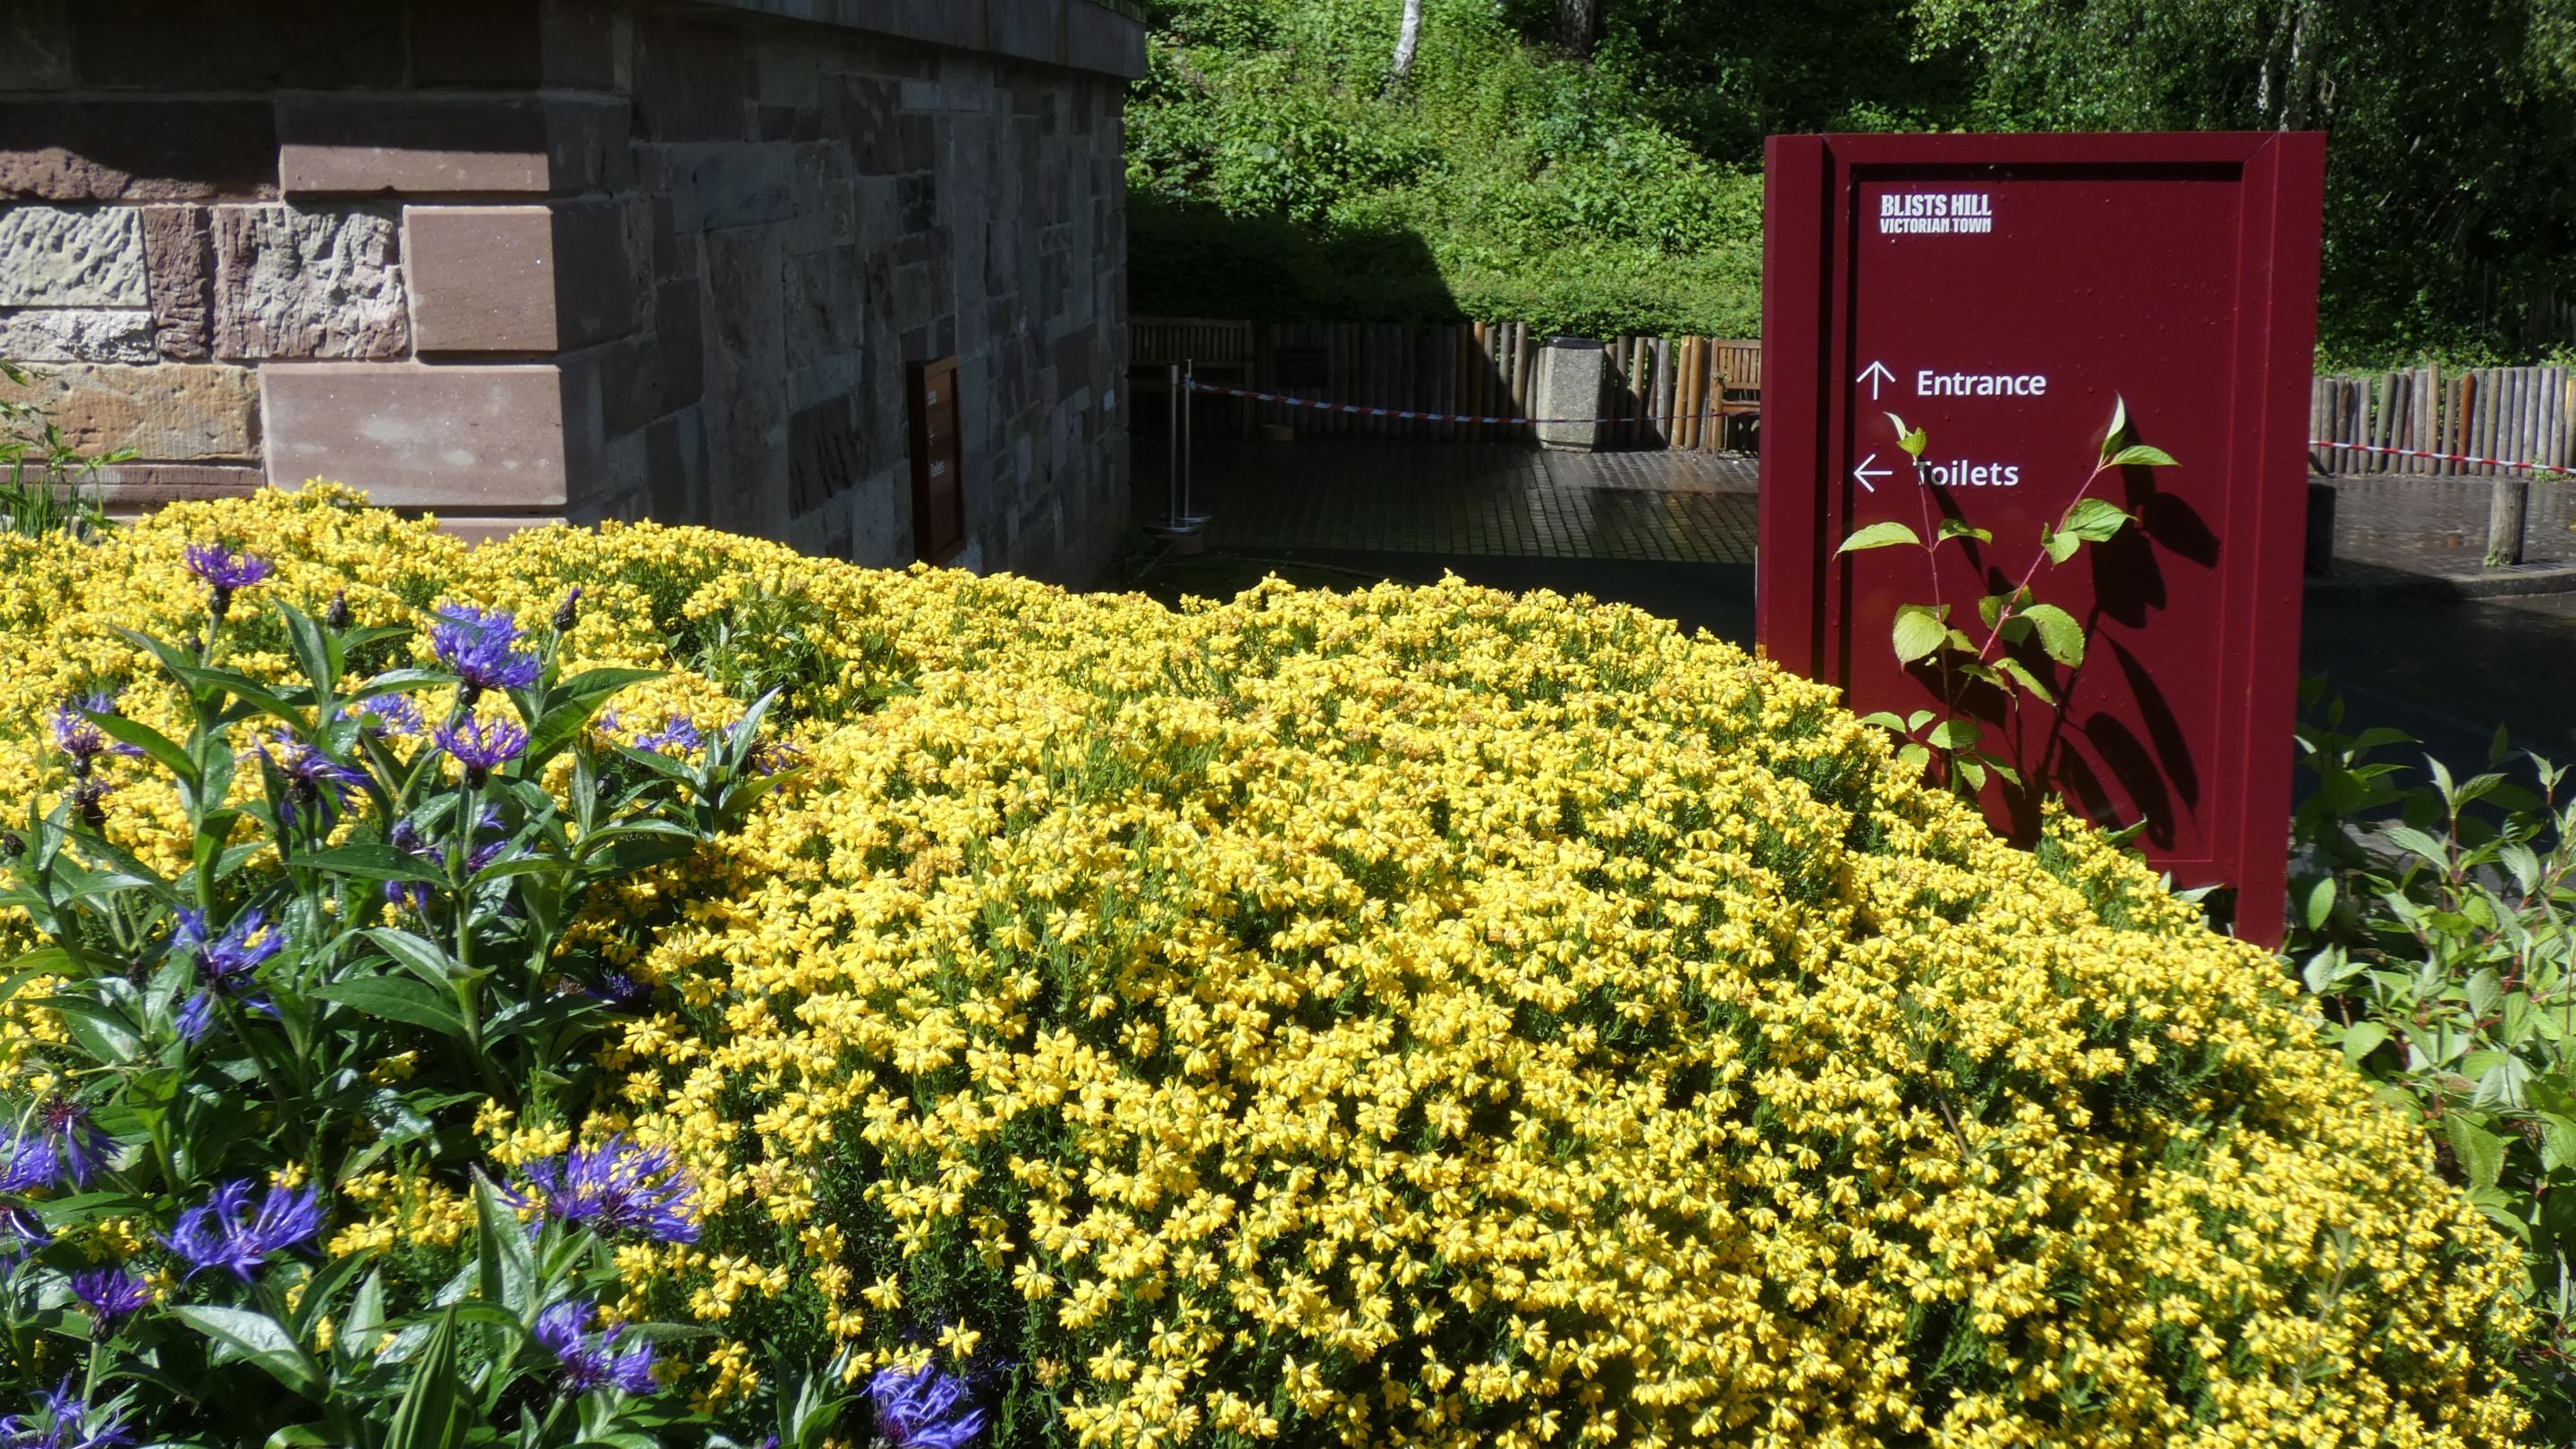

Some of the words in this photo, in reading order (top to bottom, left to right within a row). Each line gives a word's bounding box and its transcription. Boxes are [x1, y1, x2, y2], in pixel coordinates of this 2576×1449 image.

[1880, 194, 1948, 216] BLISTS
[1951, 194, 1993, 216] HILL
[1879, 217, 1950, 233] VICTORIAN
[1952, 217, 1992, 233] TOWN
[1917, 370, 2046, 396] Entrance
[1912, 459, 2020, 486] Toilets
